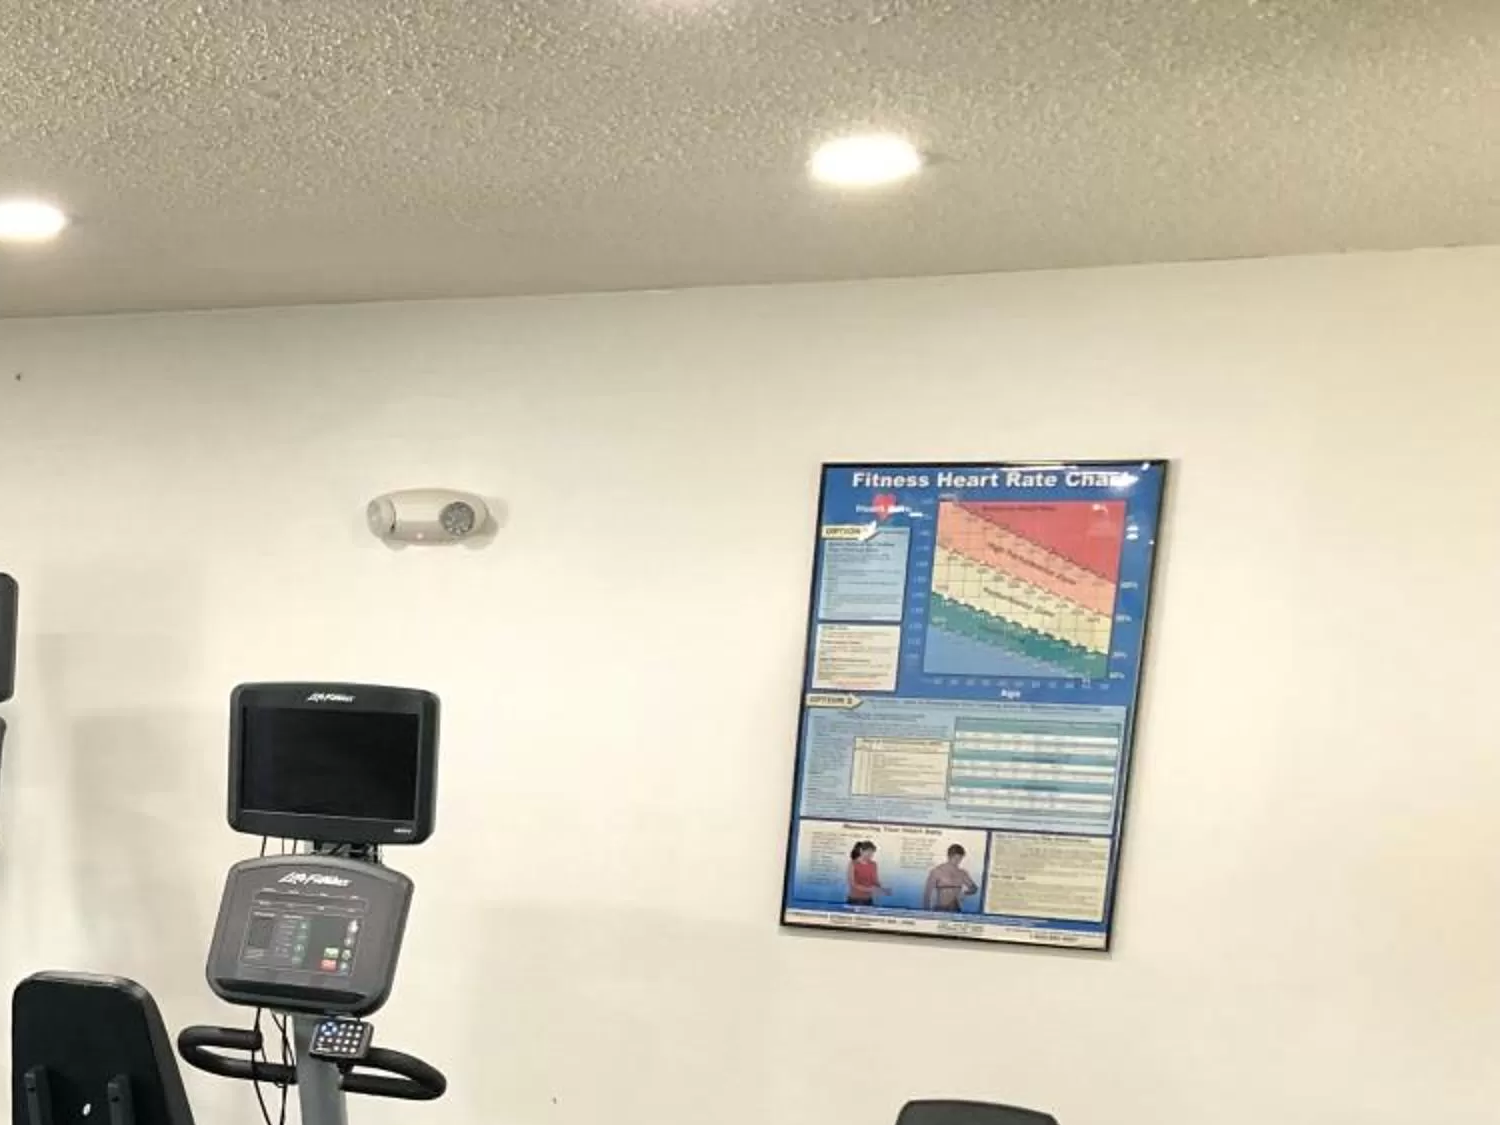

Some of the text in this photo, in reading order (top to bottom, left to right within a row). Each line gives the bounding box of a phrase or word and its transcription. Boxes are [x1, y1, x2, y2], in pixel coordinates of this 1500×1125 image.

[852, 471, 1132, 489] Fitness Heart Rate Cha
